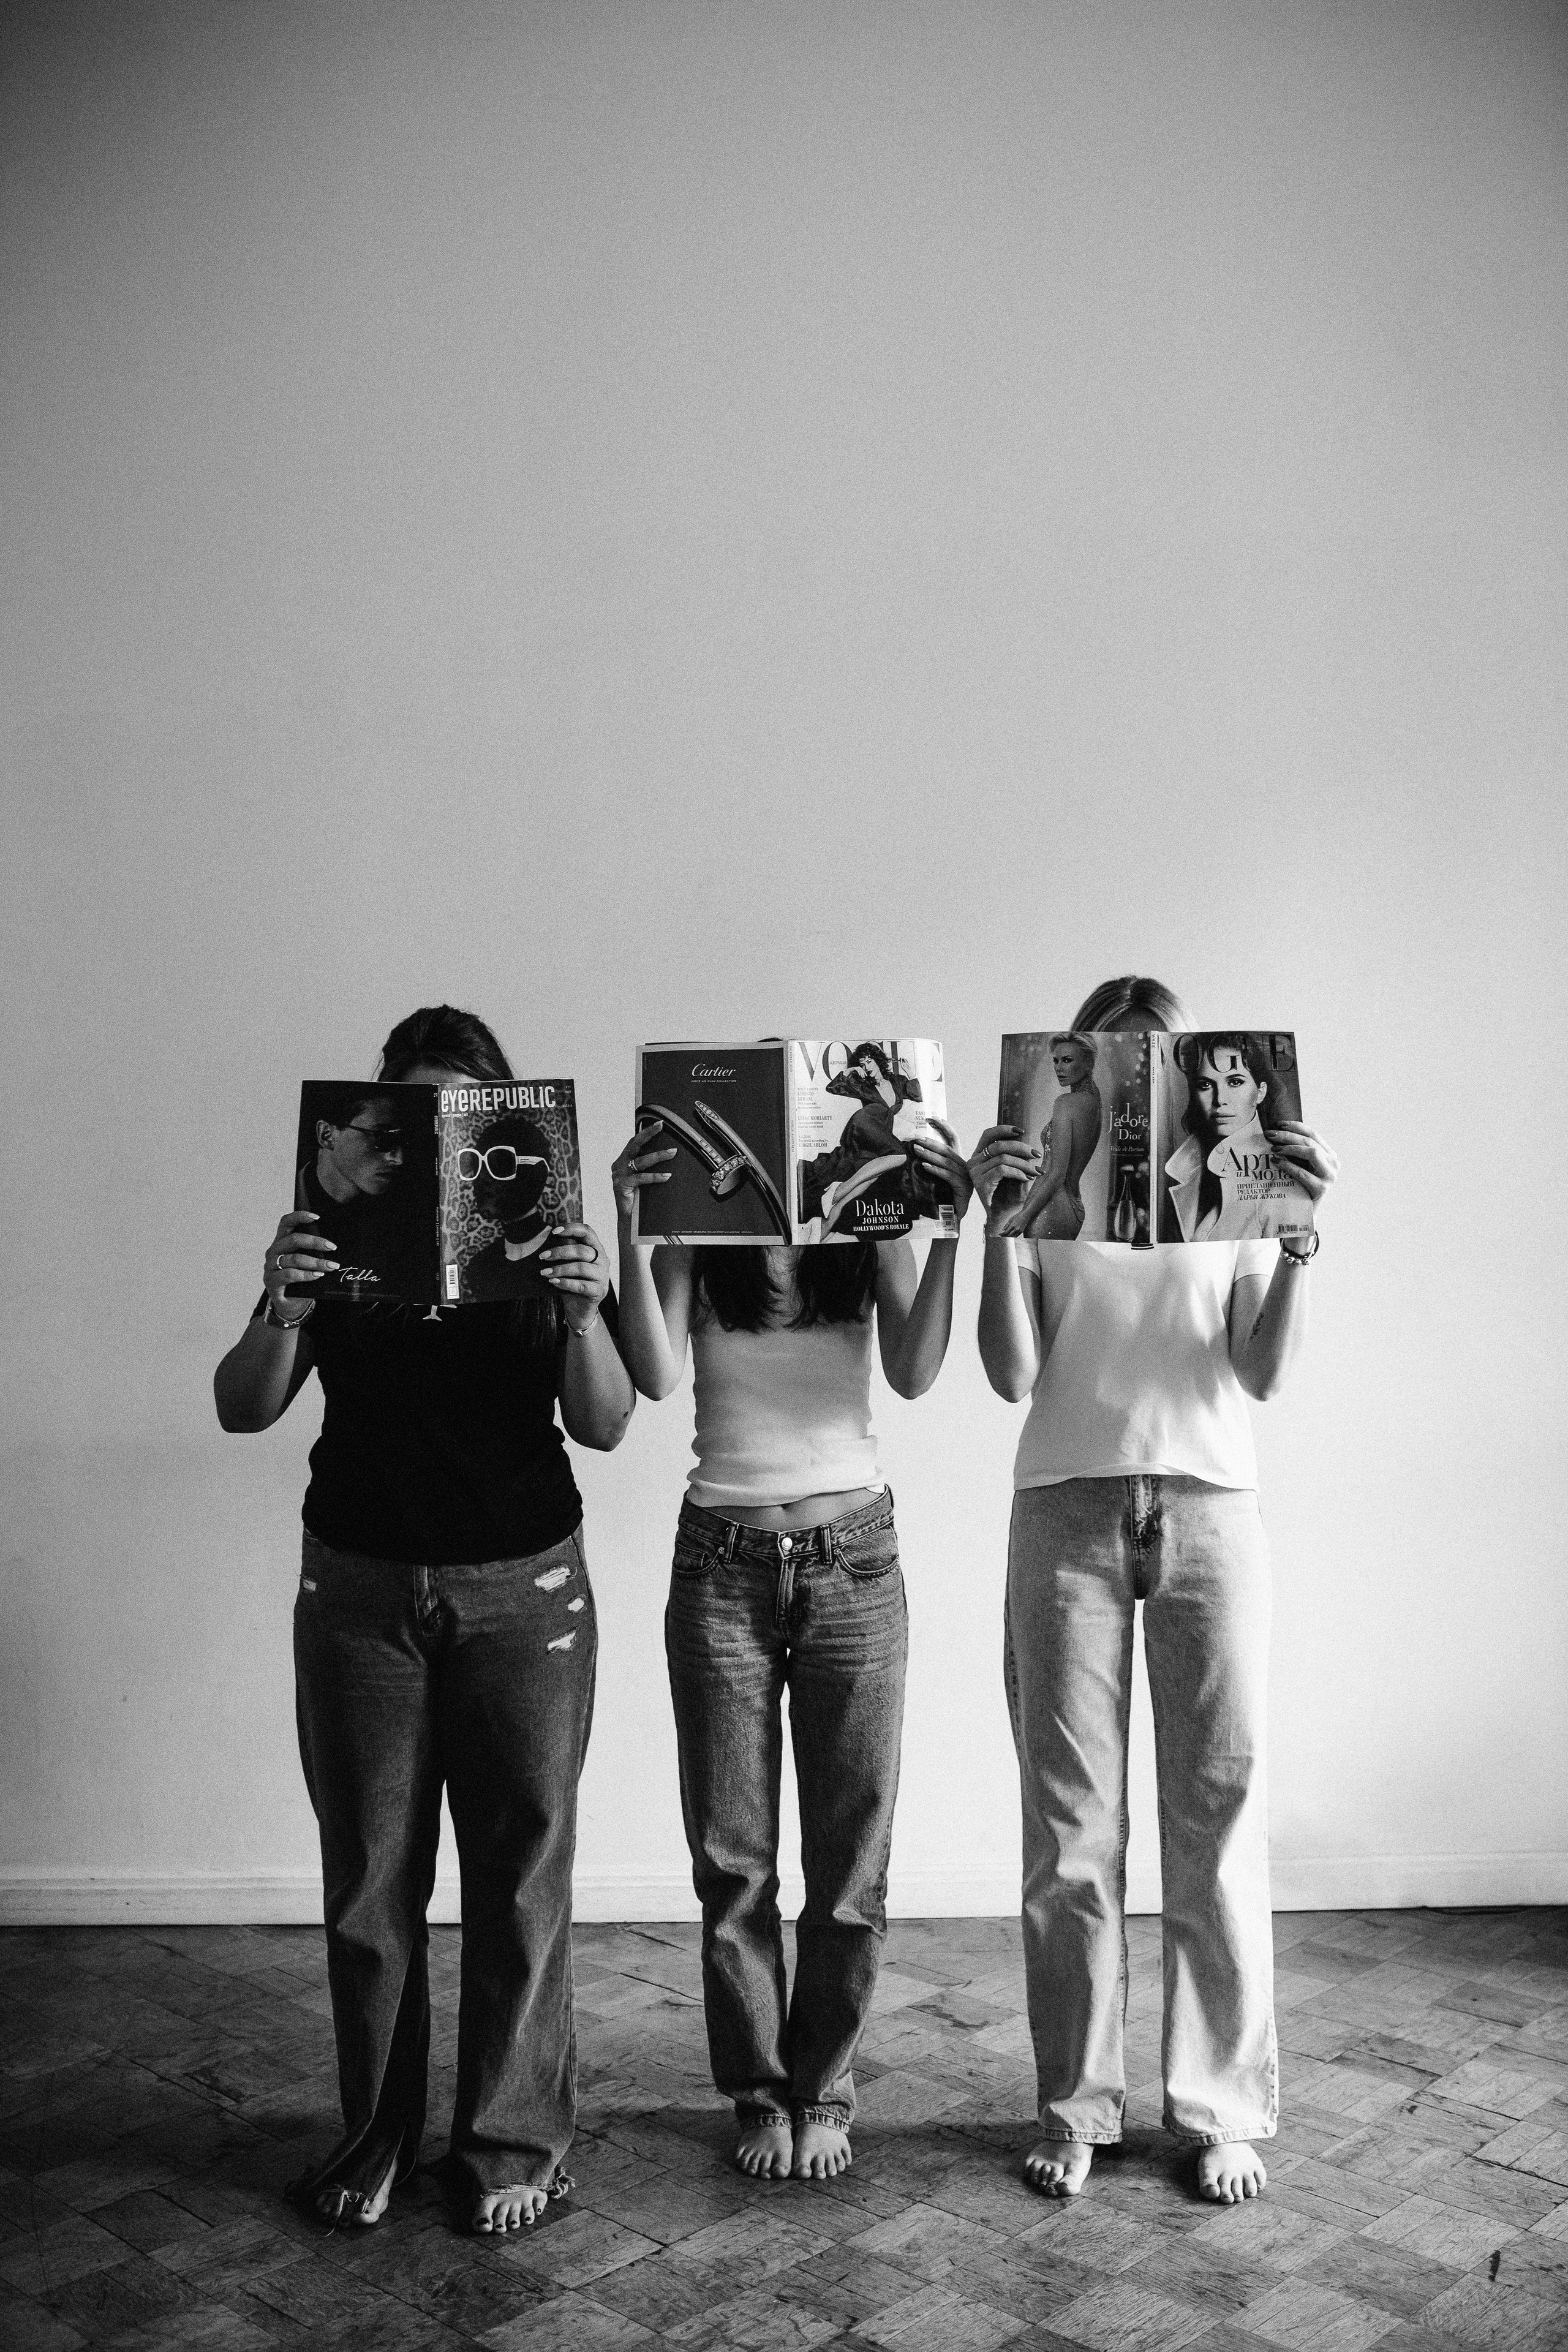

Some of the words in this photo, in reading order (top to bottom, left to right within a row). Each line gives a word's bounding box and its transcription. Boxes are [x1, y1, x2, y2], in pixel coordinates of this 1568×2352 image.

[797, 1041, 943, 1082] VOU
[692, 1063, 736, 1076] Cartier
[1118, 1128, 1142, 1140] Dior
[1237, 1181, 1295, 1189] ПРИГЛАШЕННЫЙ
[856, 1199, 905, 1216] Dakota
[339, 1267, 381, 1283] Talla
